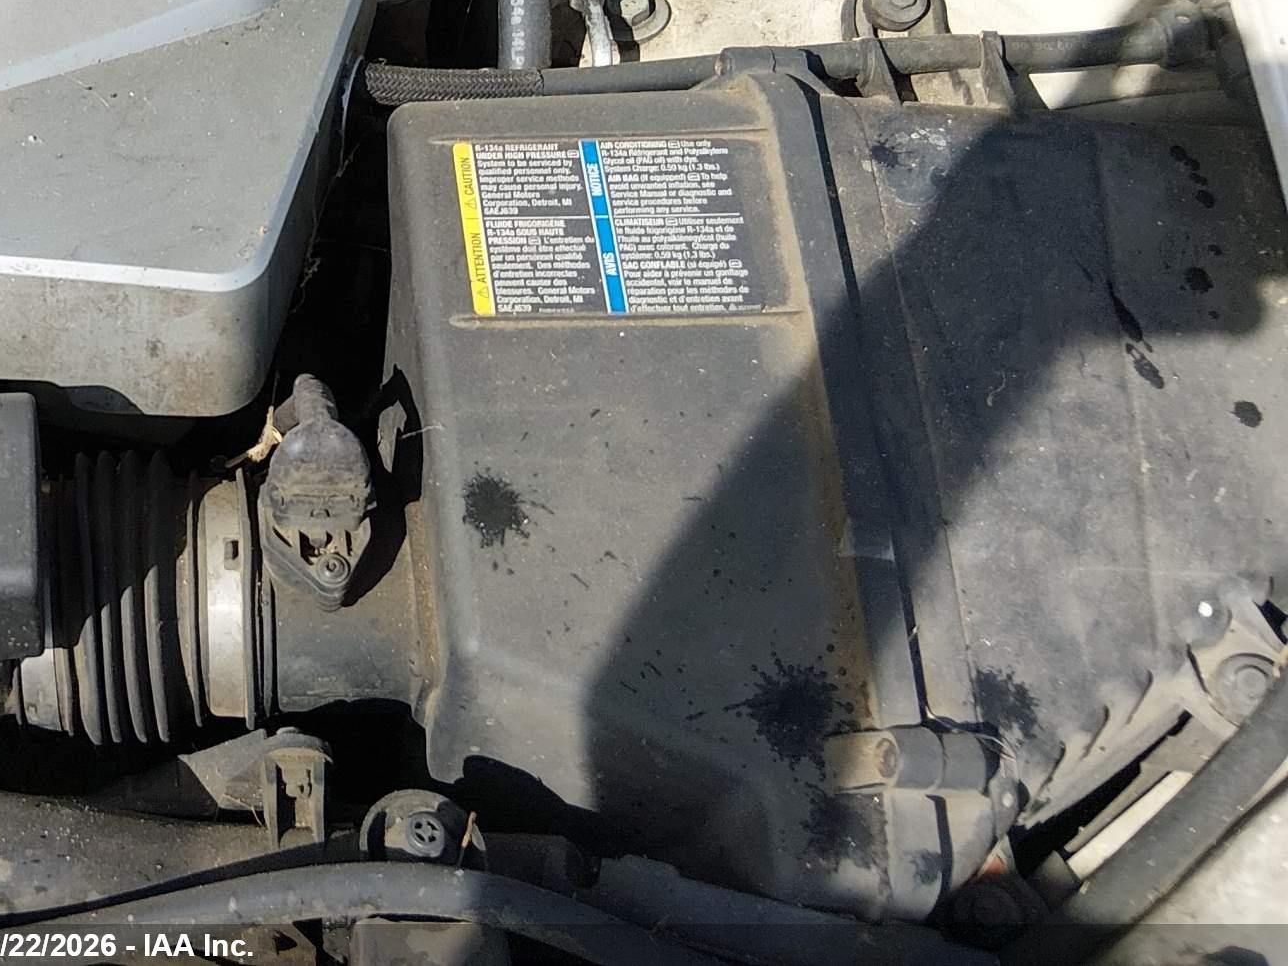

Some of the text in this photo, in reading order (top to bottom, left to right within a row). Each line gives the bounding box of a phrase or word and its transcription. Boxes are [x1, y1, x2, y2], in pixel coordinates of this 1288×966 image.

[462, 157, 474, 195] CAUTION
[586, 162, 603, 197] NOTICE
[470, 232, 486, 283] ATTENTION
[602, 251, 619, 276] AVIS
